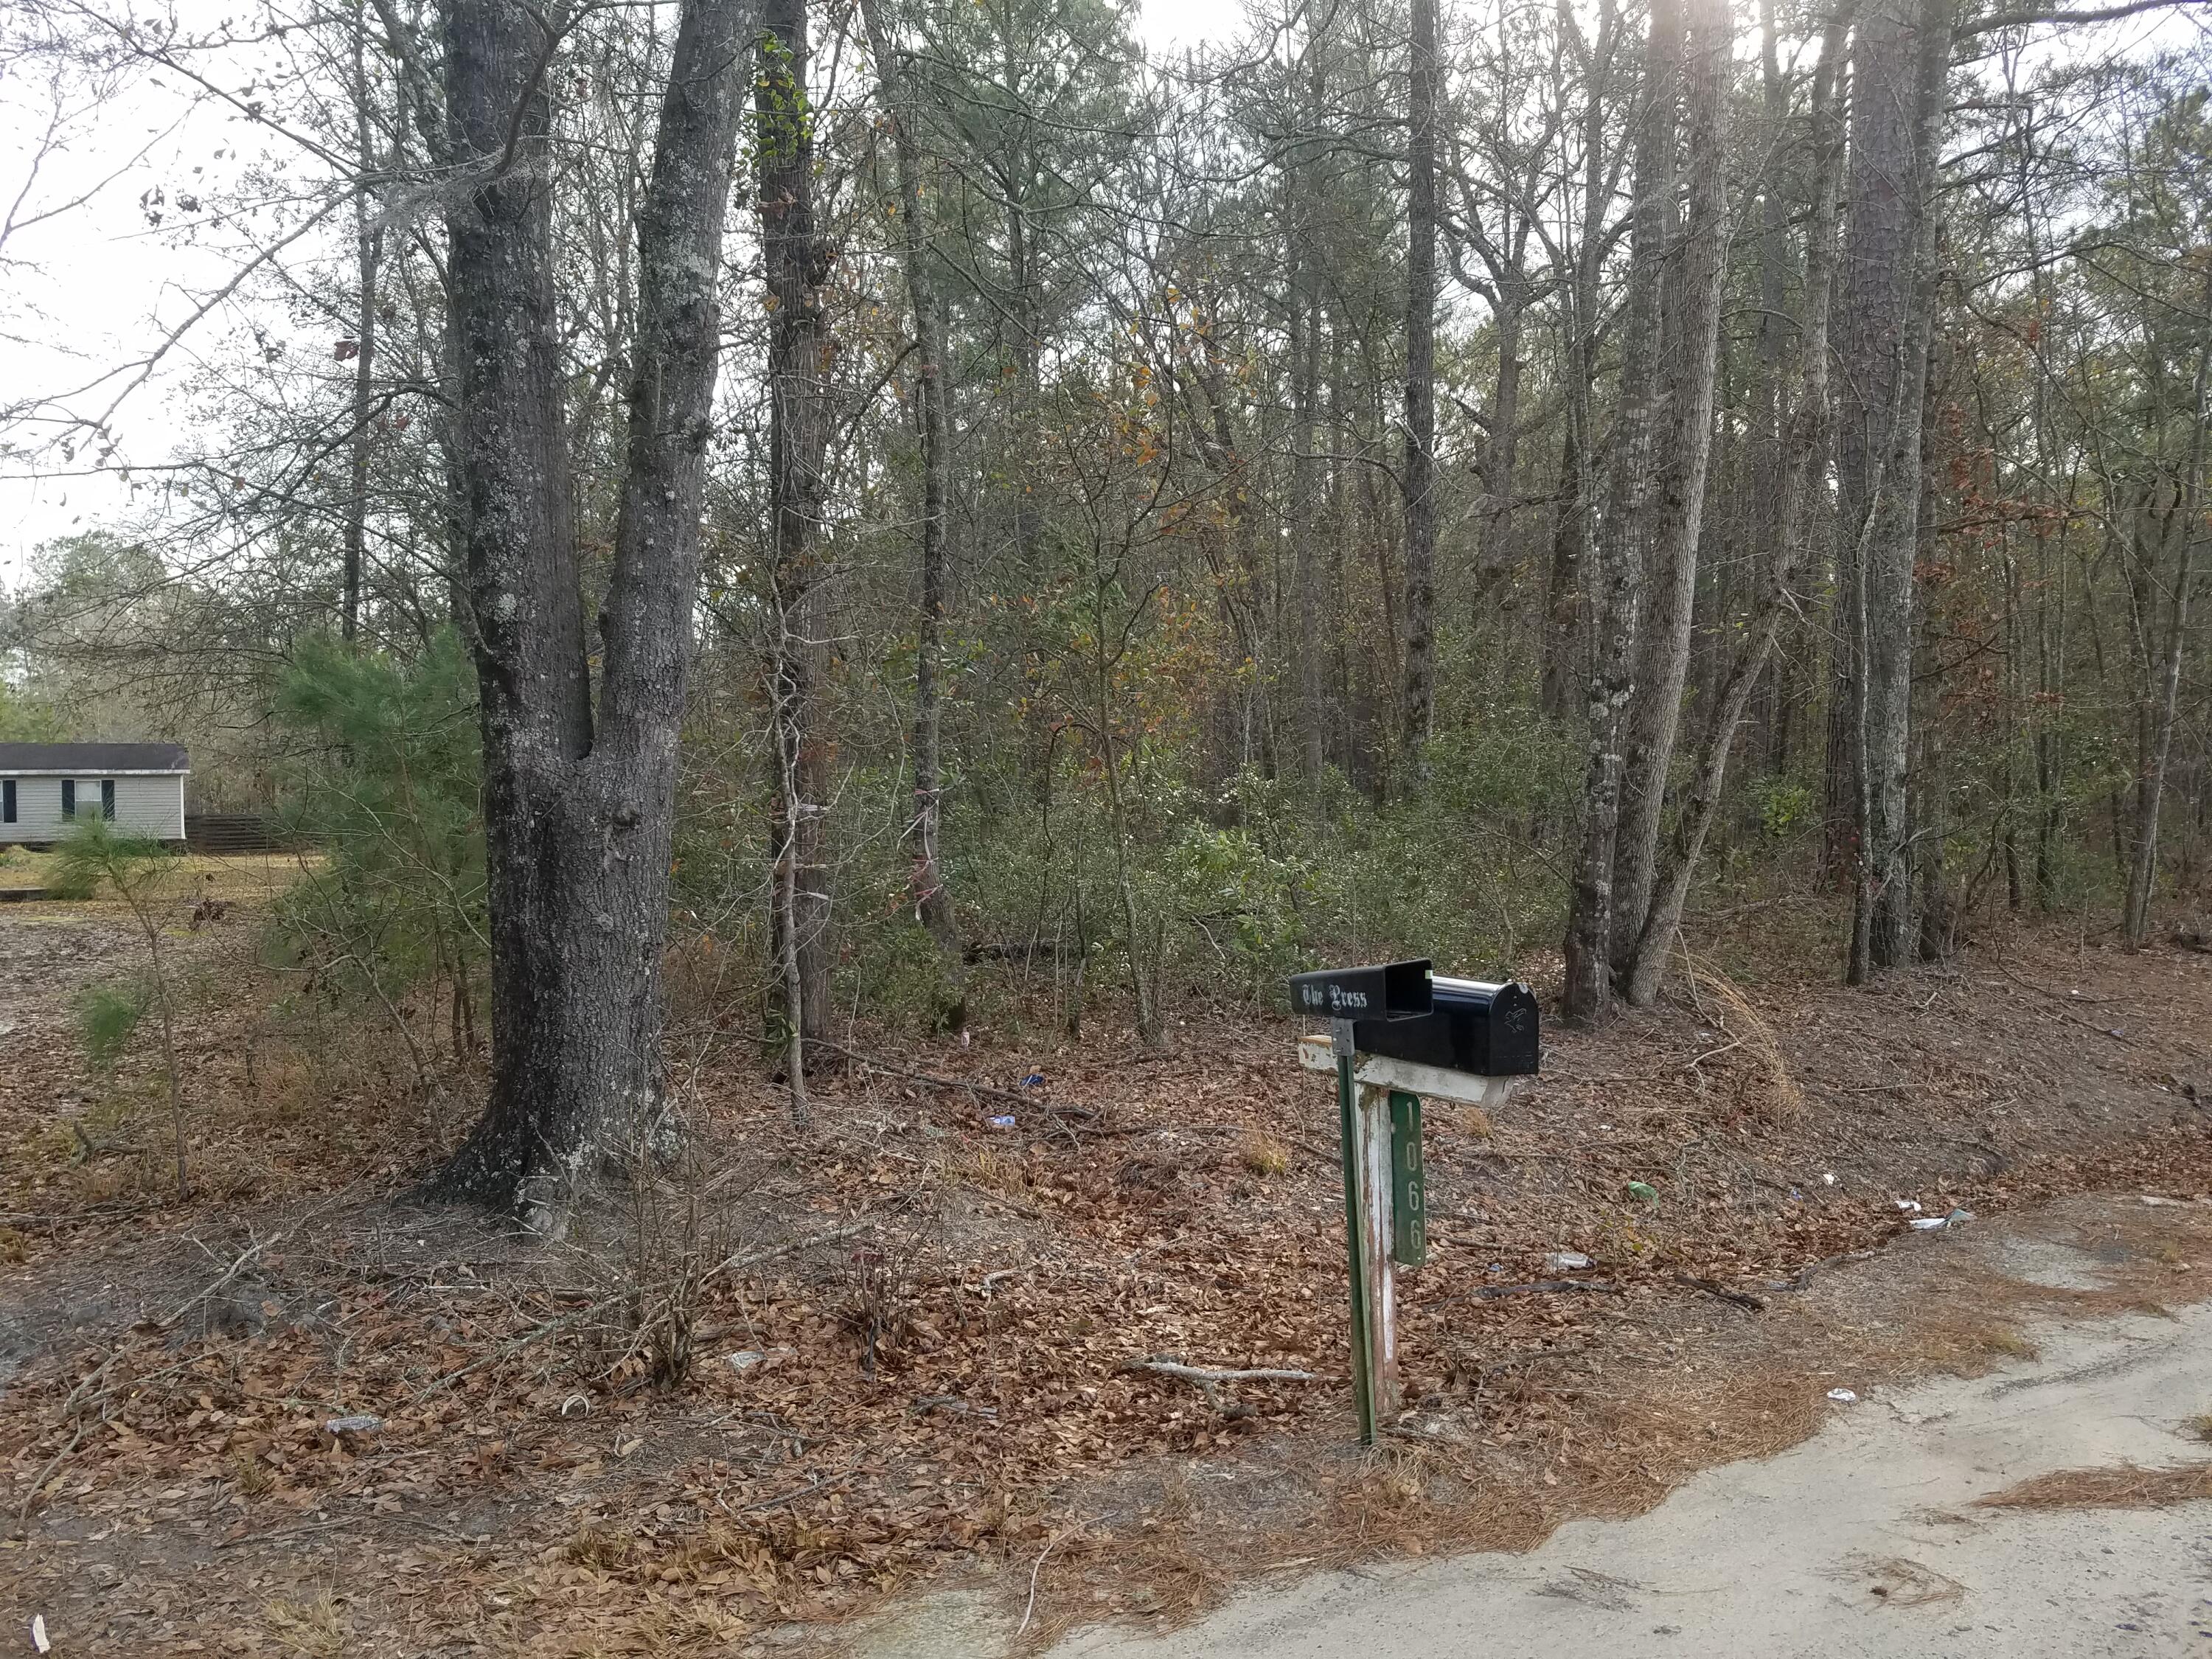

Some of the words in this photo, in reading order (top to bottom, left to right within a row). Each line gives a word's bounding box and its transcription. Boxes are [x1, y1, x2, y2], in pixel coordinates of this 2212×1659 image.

[1302, 984, 1324, 1006] The
[1329, 984, 1368, 1011] Press
[1405, 1101, 1422, 1250] 1066
